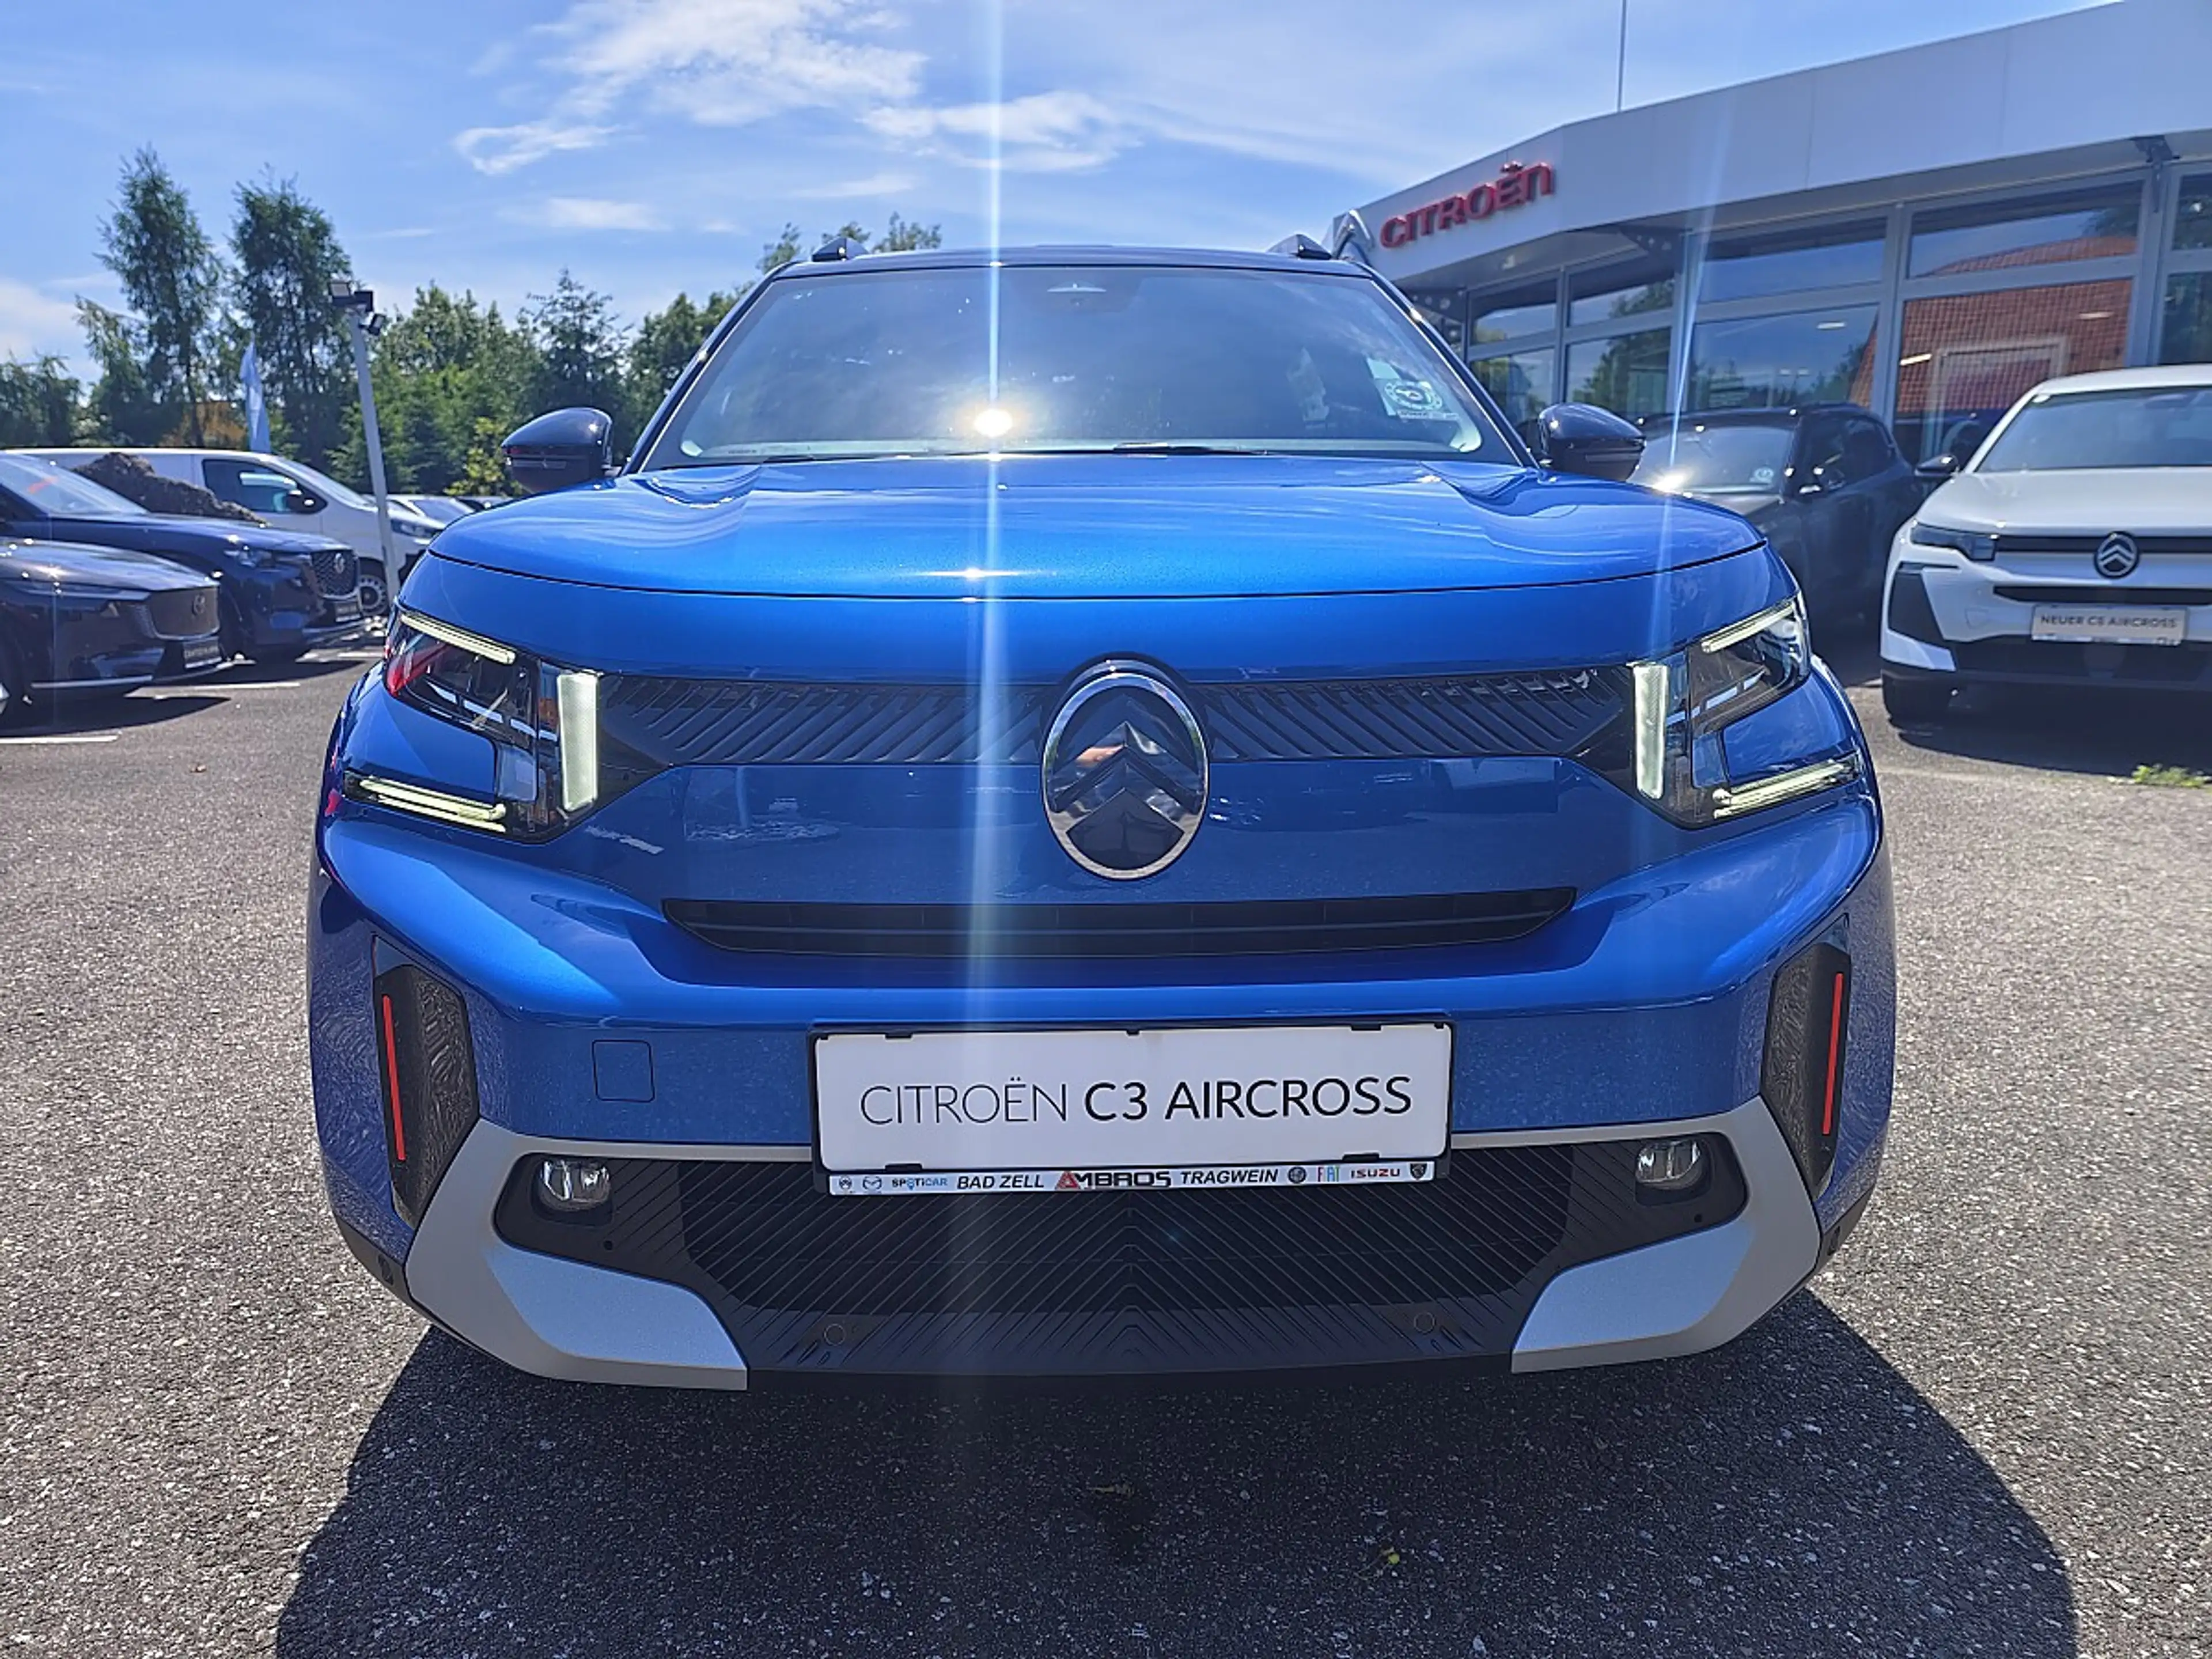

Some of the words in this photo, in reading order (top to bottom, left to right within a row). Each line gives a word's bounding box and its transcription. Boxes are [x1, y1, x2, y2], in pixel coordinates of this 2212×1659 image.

[2107, 616, 2177, 628] AIRCROSS
[860, 1077, 1066, 1124] CITROËN
[1085, 1081, 1147, 1121] C3
[1164, 1076, 1412, 1120] AIRCROSS
[957, 1175, 995, 1190] BAD
[999, 1174, 1044, 1188] ZELL
[1055, 1170, 1172, 1190] AMBROS
[1181, 1168, 1279, 1184] TRAGWEIN
[1351, 1168, 1400, 1179] ISUZU
